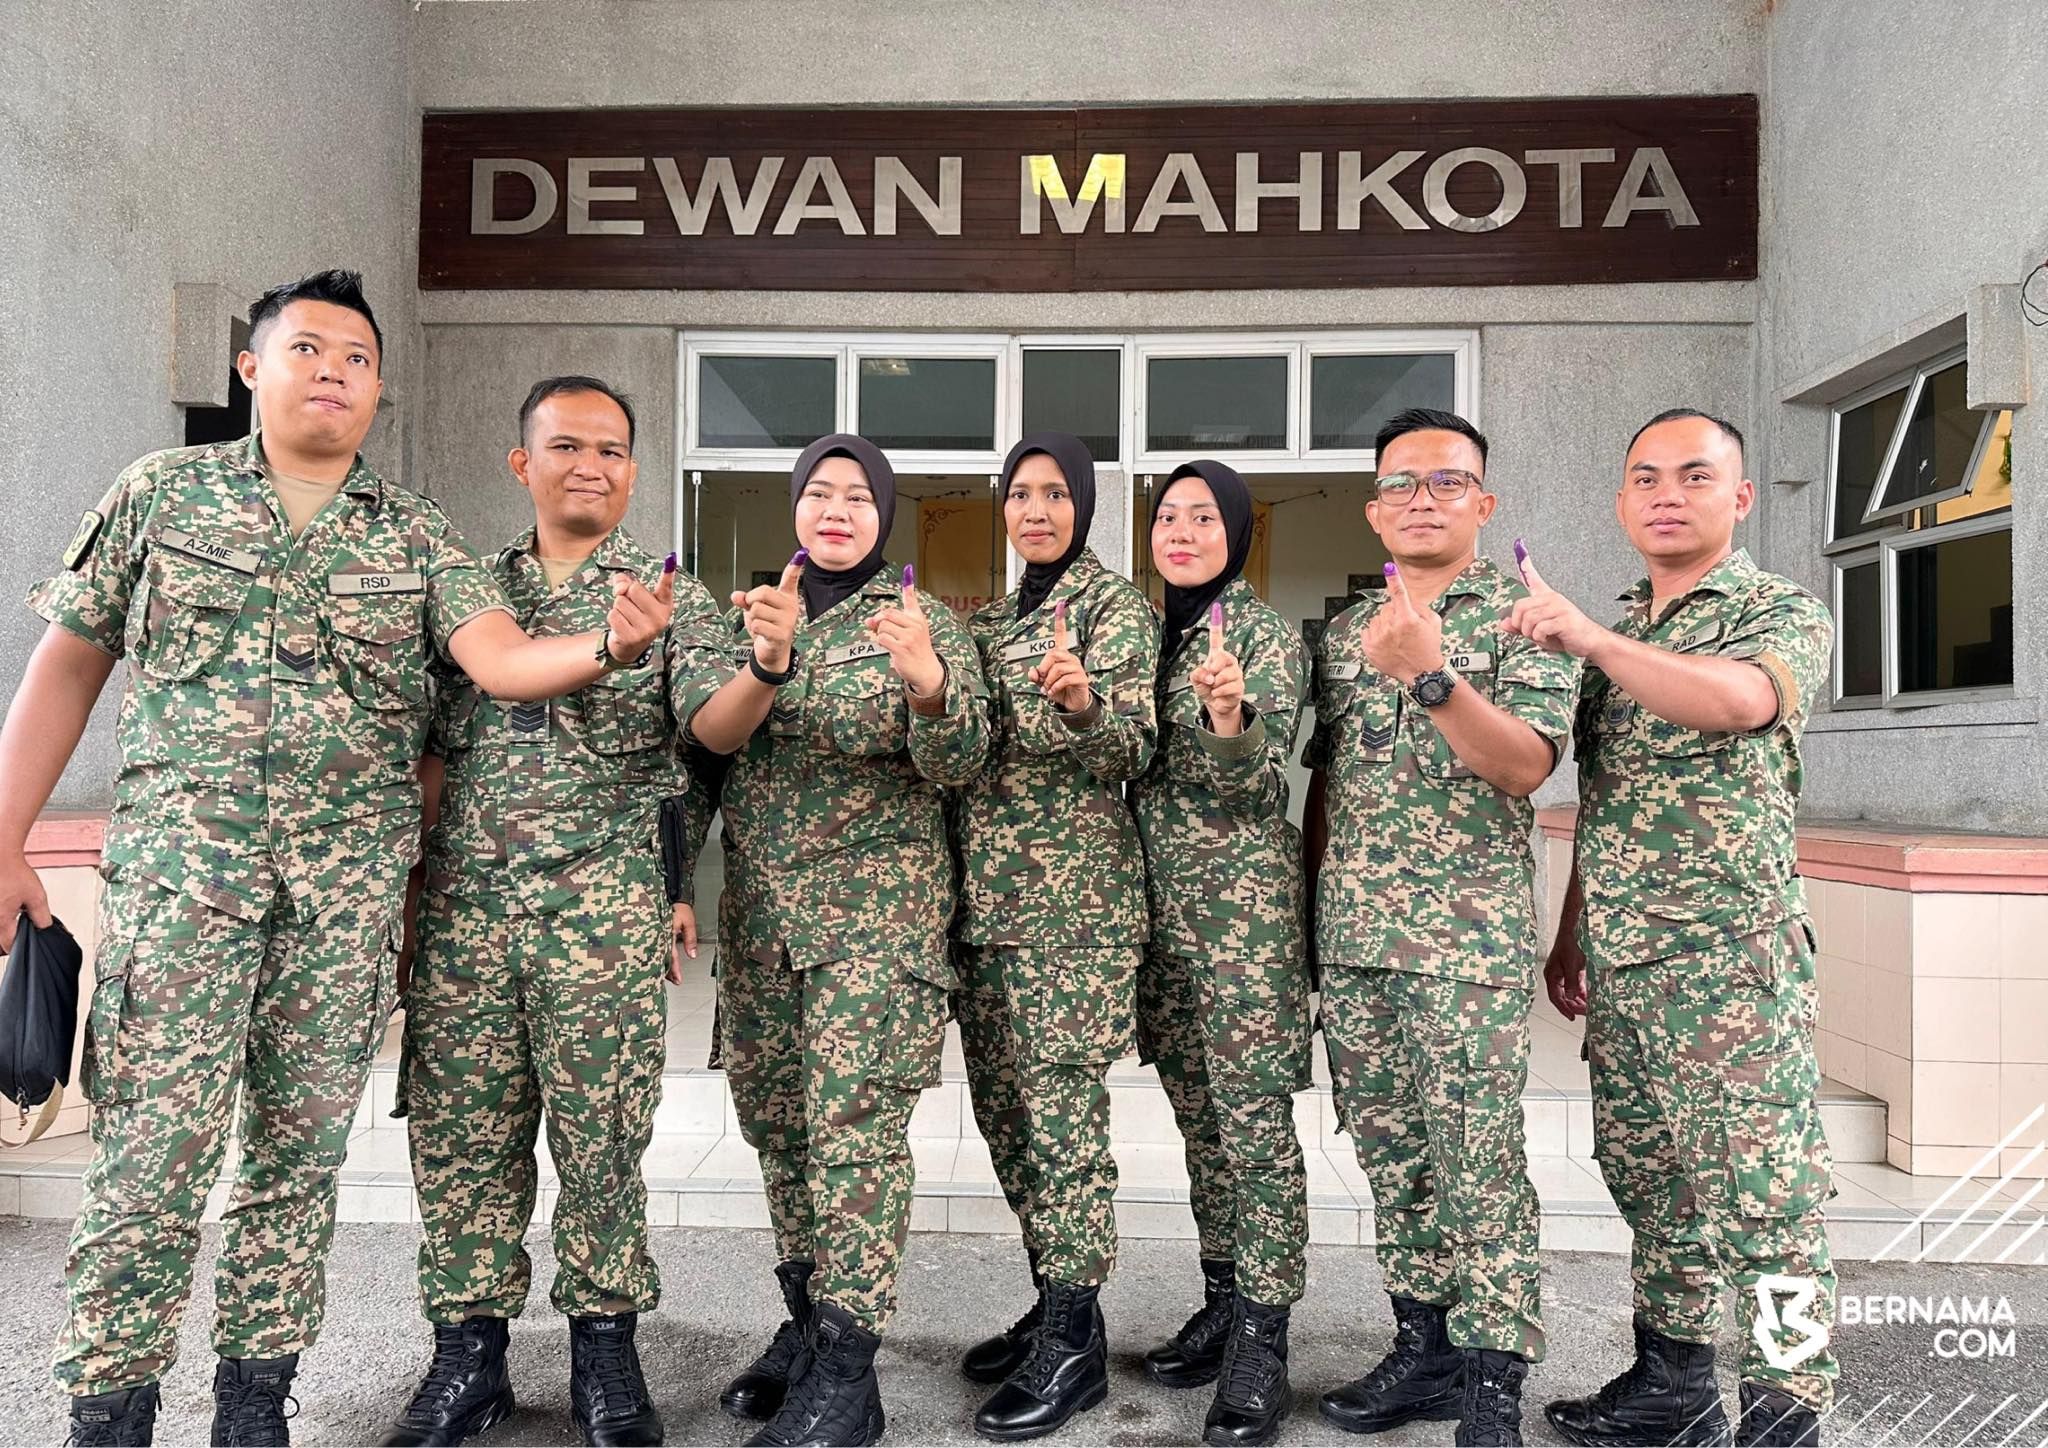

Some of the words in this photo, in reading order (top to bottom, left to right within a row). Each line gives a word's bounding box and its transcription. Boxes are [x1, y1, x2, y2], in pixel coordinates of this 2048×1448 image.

[470, 156, 962, 236] DEWAN
[1019, 146, 1701, 235] MAHKOTA
[184, 538, 234, 561] AZMIE
[360, 576, 391, 589] RSD
[849, 644, 875, 656] KPA
[1030, 639, 1056, 653] KKD
[1672, 635, 1696, 652] RAD
